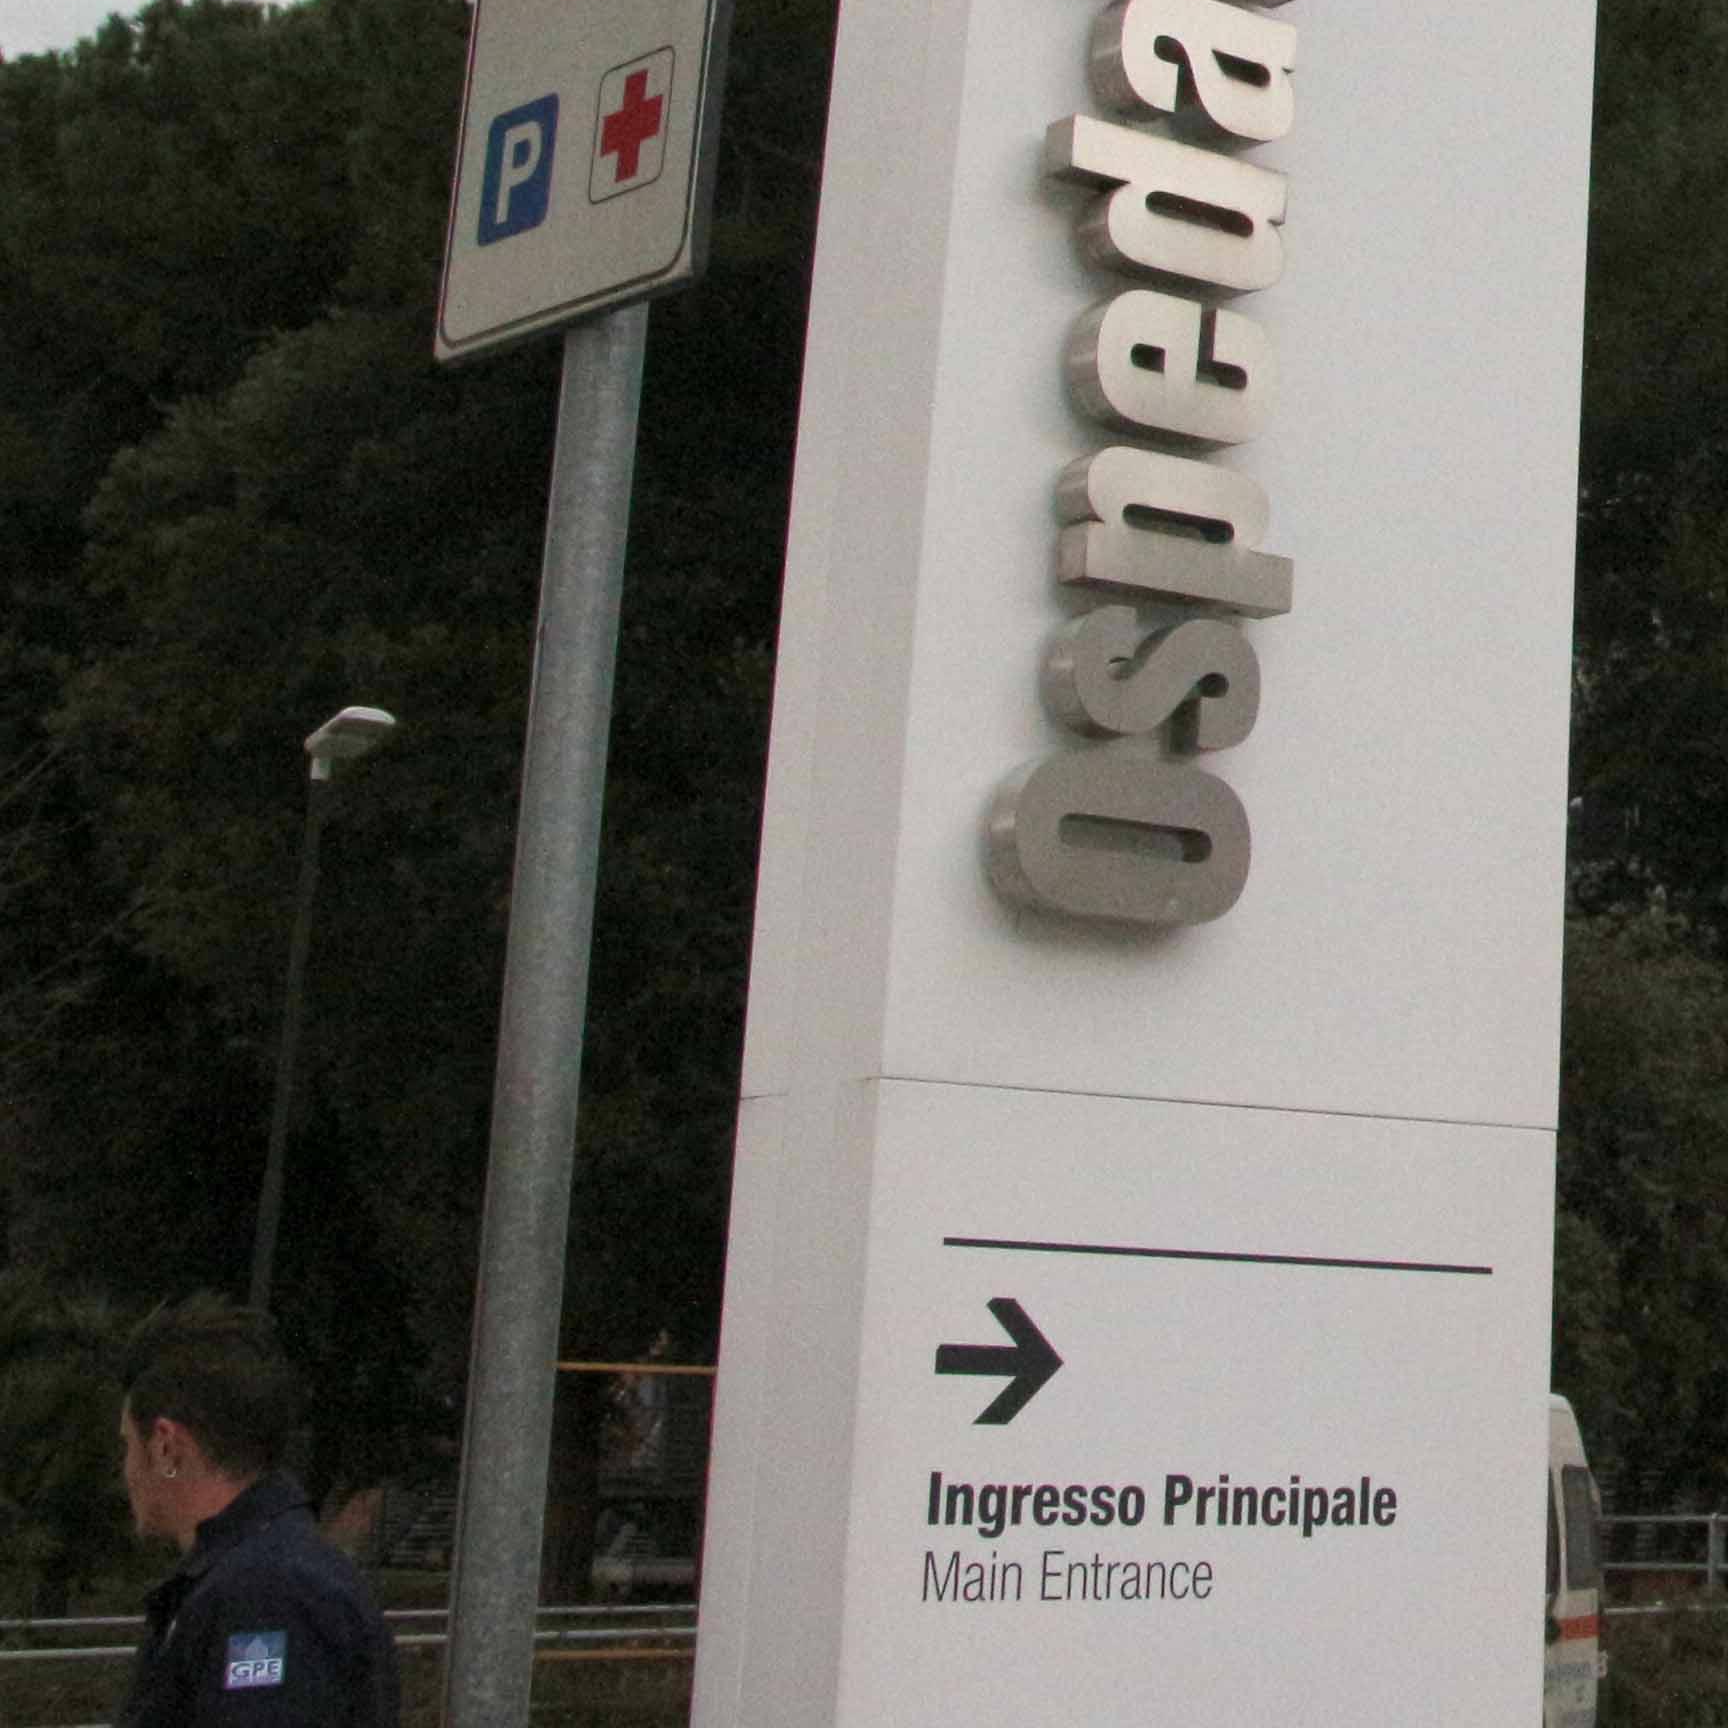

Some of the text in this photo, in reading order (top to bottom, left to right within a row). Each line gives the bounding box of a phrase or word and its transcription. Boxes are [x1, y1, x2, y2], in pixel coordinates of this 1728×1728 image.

[494, 119, 542, 225] P
[925, 1471, 1399, 1539] Ingresso Principale
[920, 1549, 1214, 1602] Main Entrance
